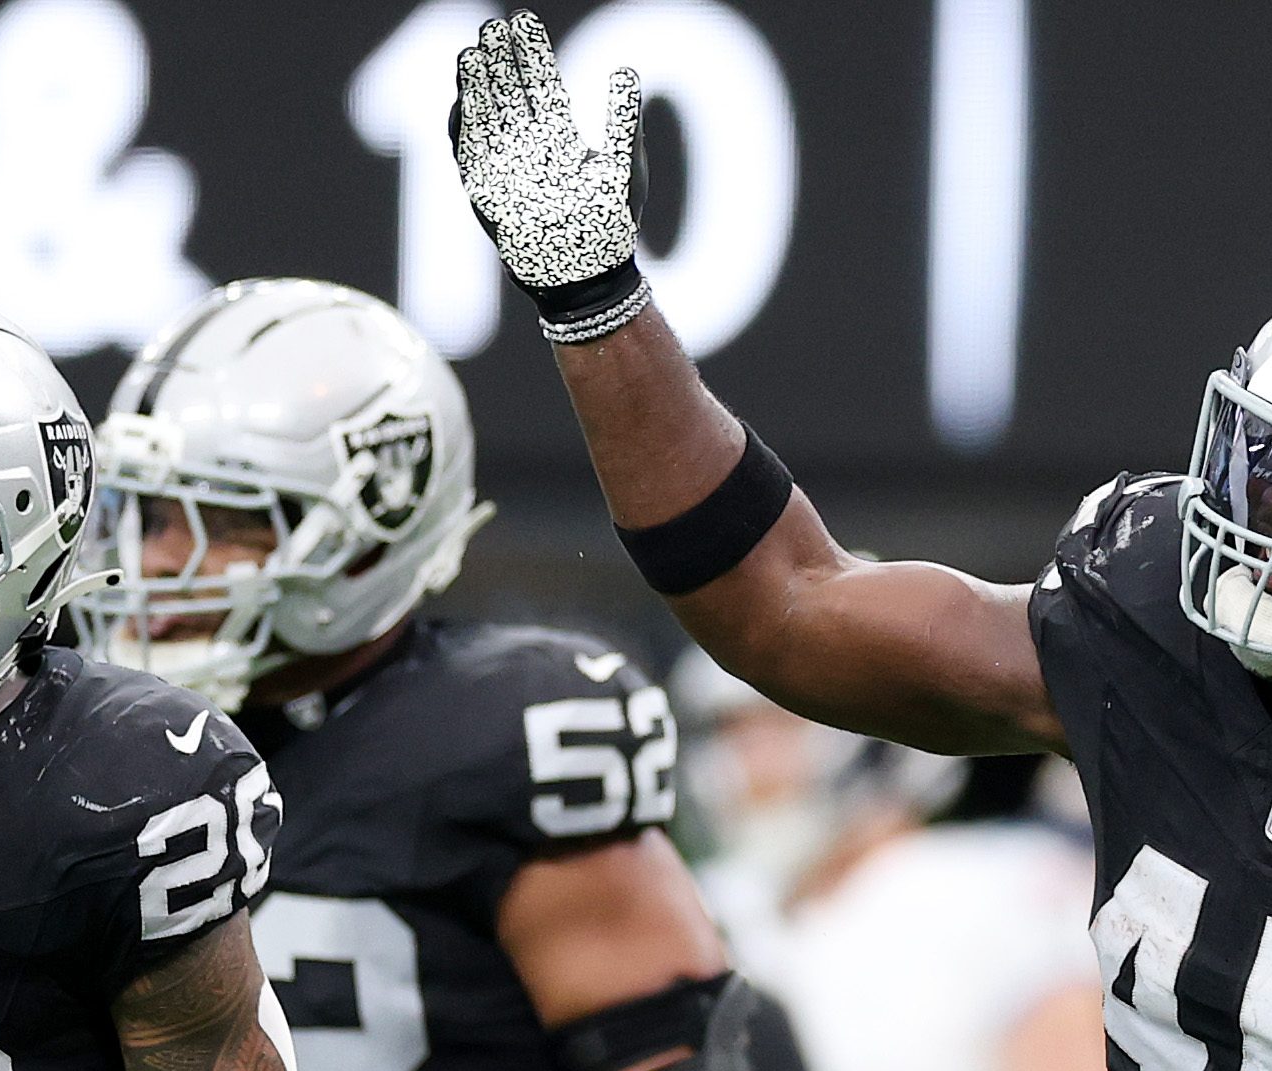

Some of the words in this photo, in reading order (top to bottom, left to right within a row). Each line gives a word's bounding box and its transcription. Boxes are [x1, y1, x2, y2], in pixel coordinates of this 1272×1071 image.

[347, 0, 799, 359] 10
[137, 761, 283, 942] 20
[524, 685, 678, 838] 52
